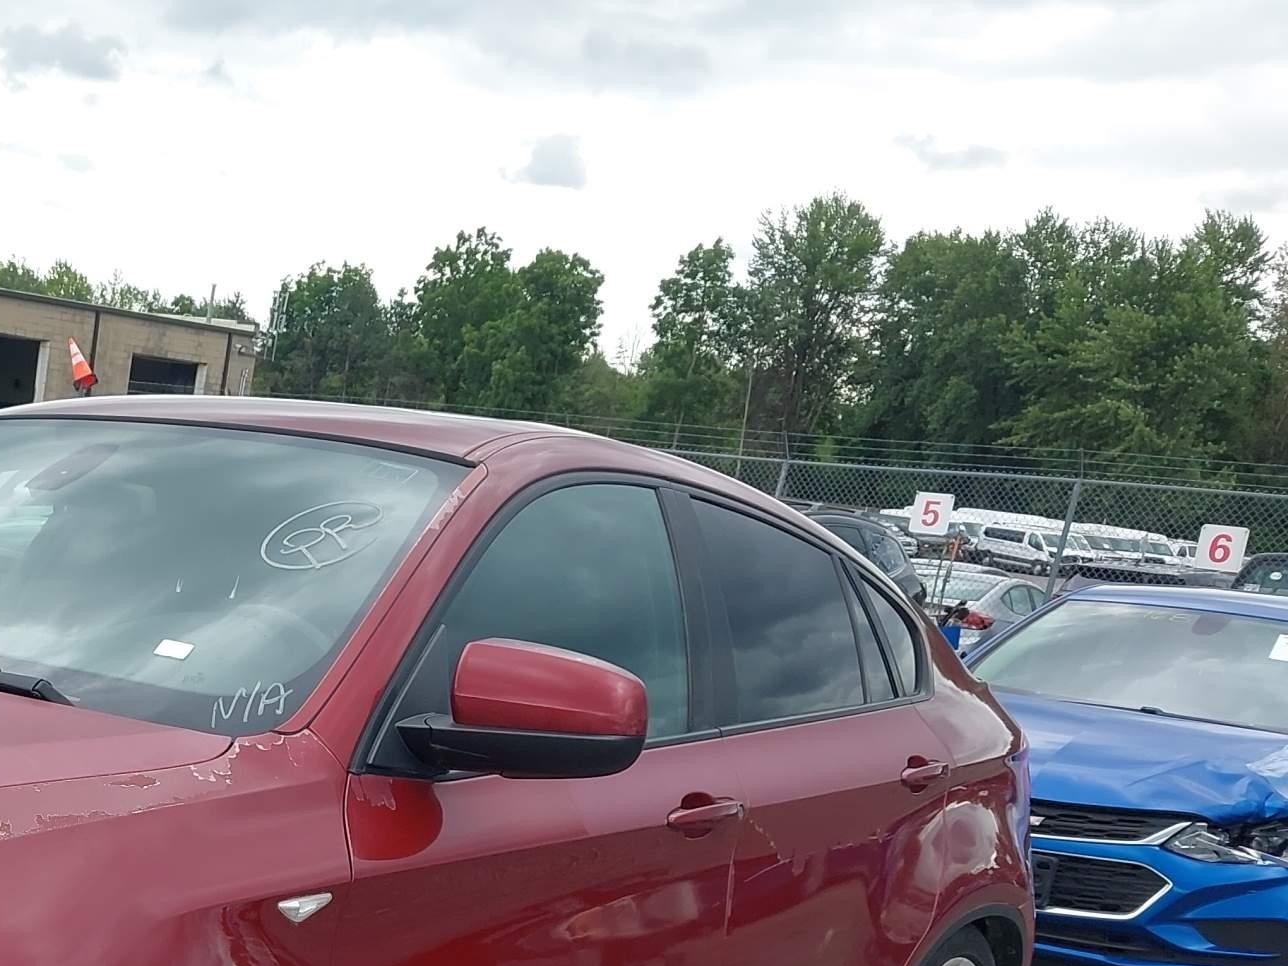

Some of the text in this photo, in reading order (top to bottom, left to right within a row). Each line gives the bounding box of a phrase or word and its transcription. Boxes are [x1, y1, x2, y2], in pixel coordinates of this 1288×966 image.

[920, 500, 942, 528] 5
[1208, 533, 1233, 563] 6
[211, 680, 293, 729] N/A
